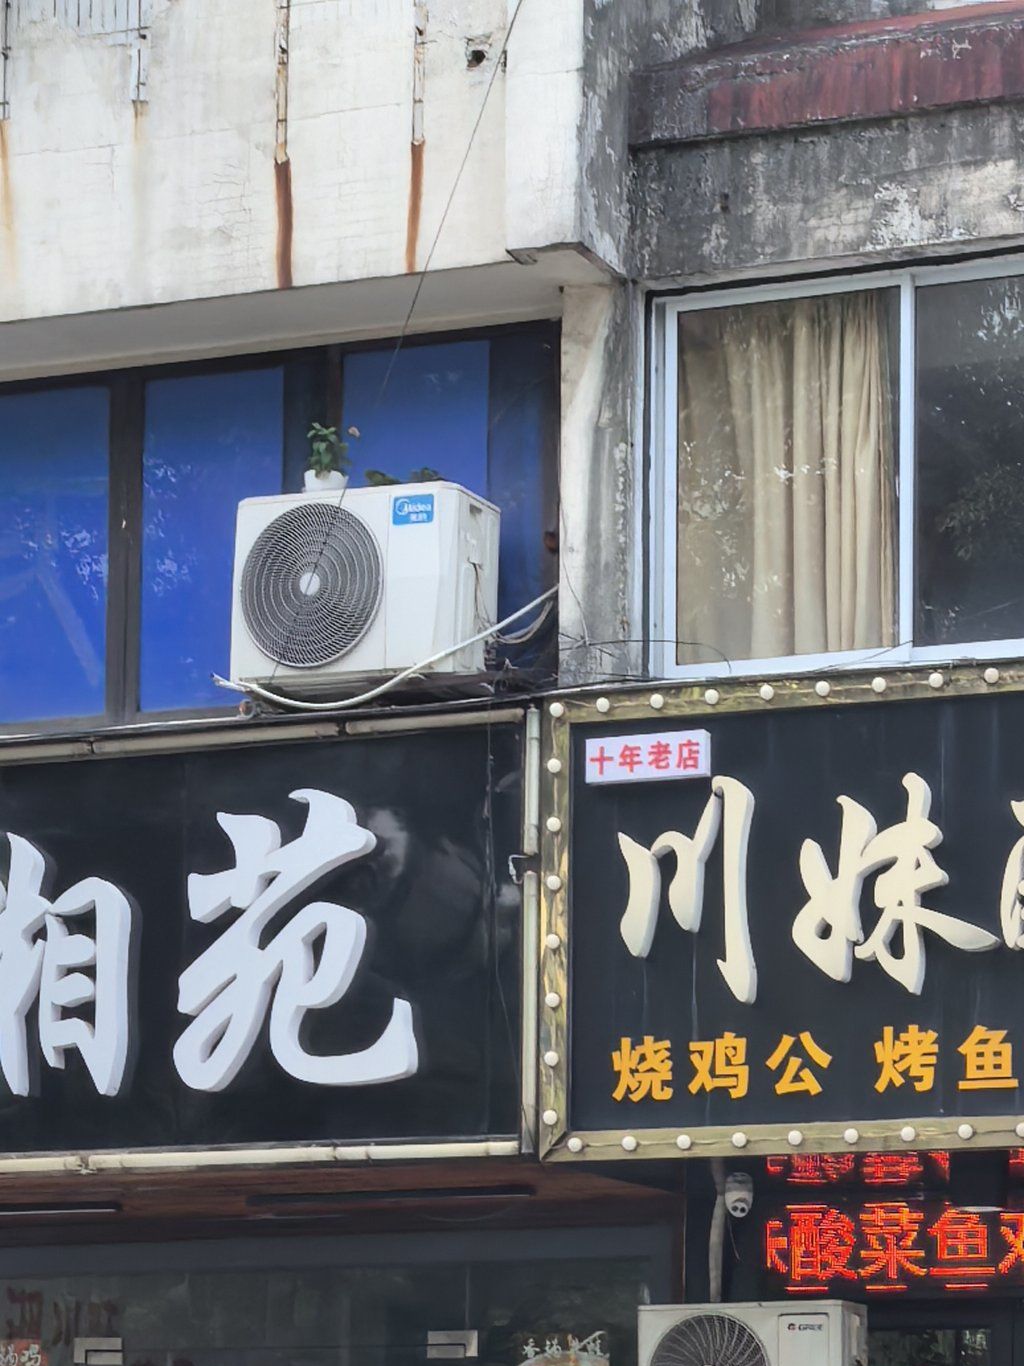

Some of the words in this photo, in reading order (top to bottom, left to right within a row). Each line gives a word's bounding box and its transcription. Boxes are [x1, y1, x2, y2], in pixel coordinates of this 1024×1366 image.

[589, 740, 702, 776] 十年老店
[612, 1030, 833, 1102] 烧鸡公
[874, 1024, 1020, 1094] 烤鱼
